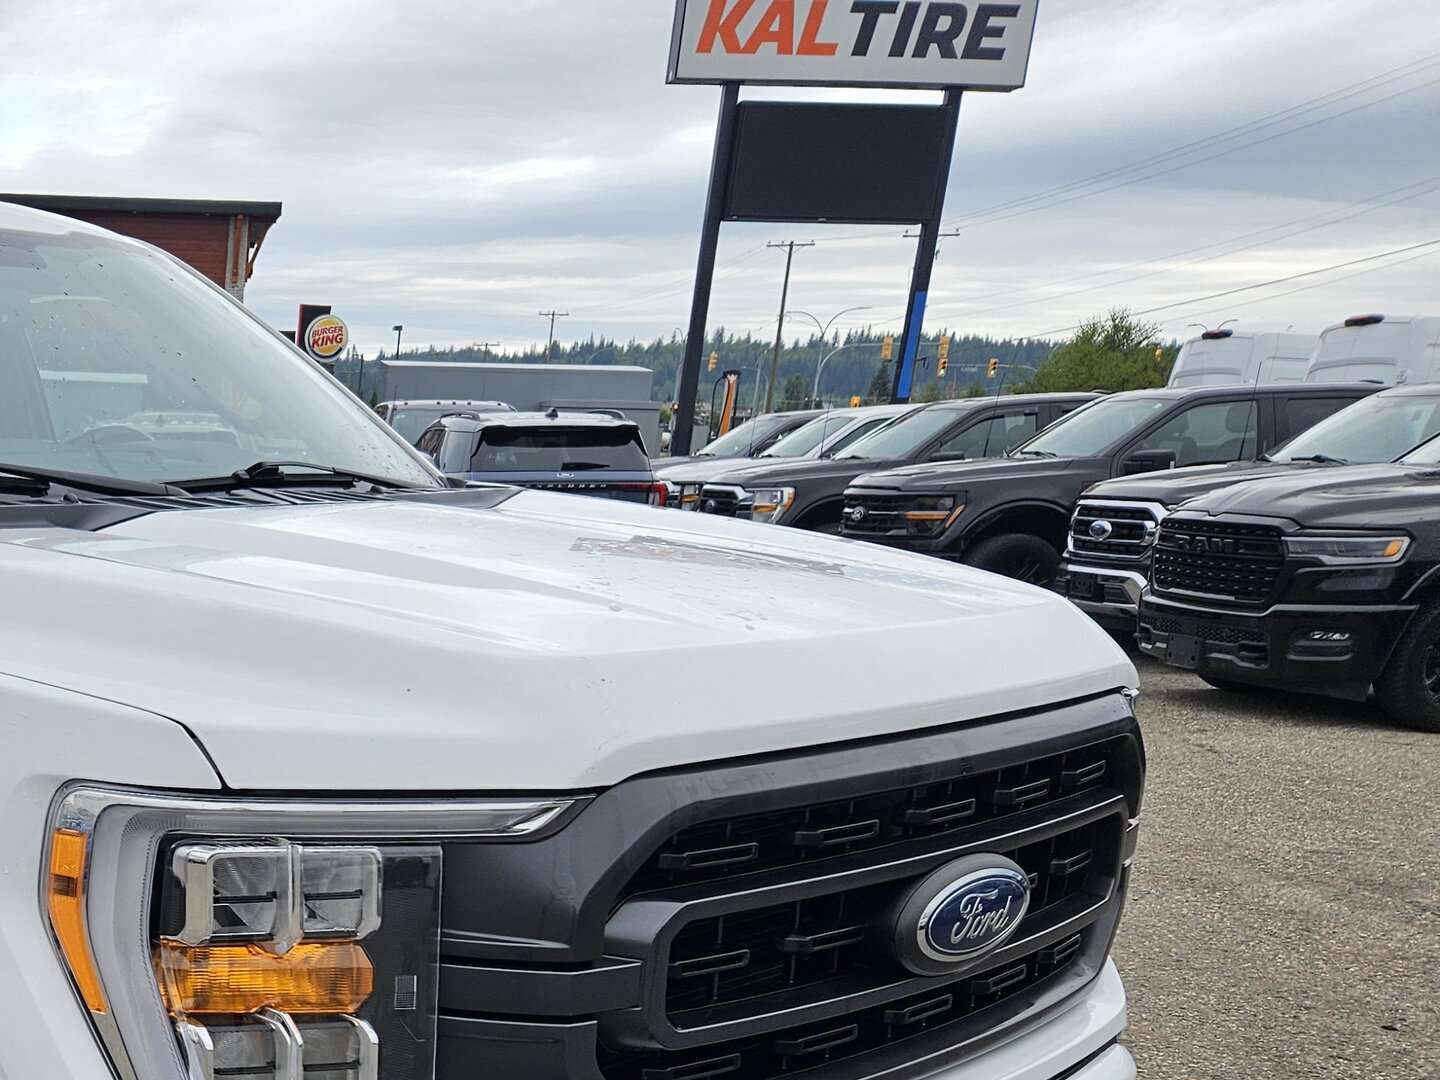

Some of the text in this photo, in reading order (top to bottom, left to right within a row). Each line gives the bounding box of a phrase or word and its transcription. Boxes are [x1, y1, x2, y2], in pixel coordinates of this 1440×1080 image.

[695, 0, 1022, 60] KAL TIRE
[312, 325, 344, 338] BURGER
[312, 334, 343, 349] KING
[950, 888, 1013, 945] Ford
